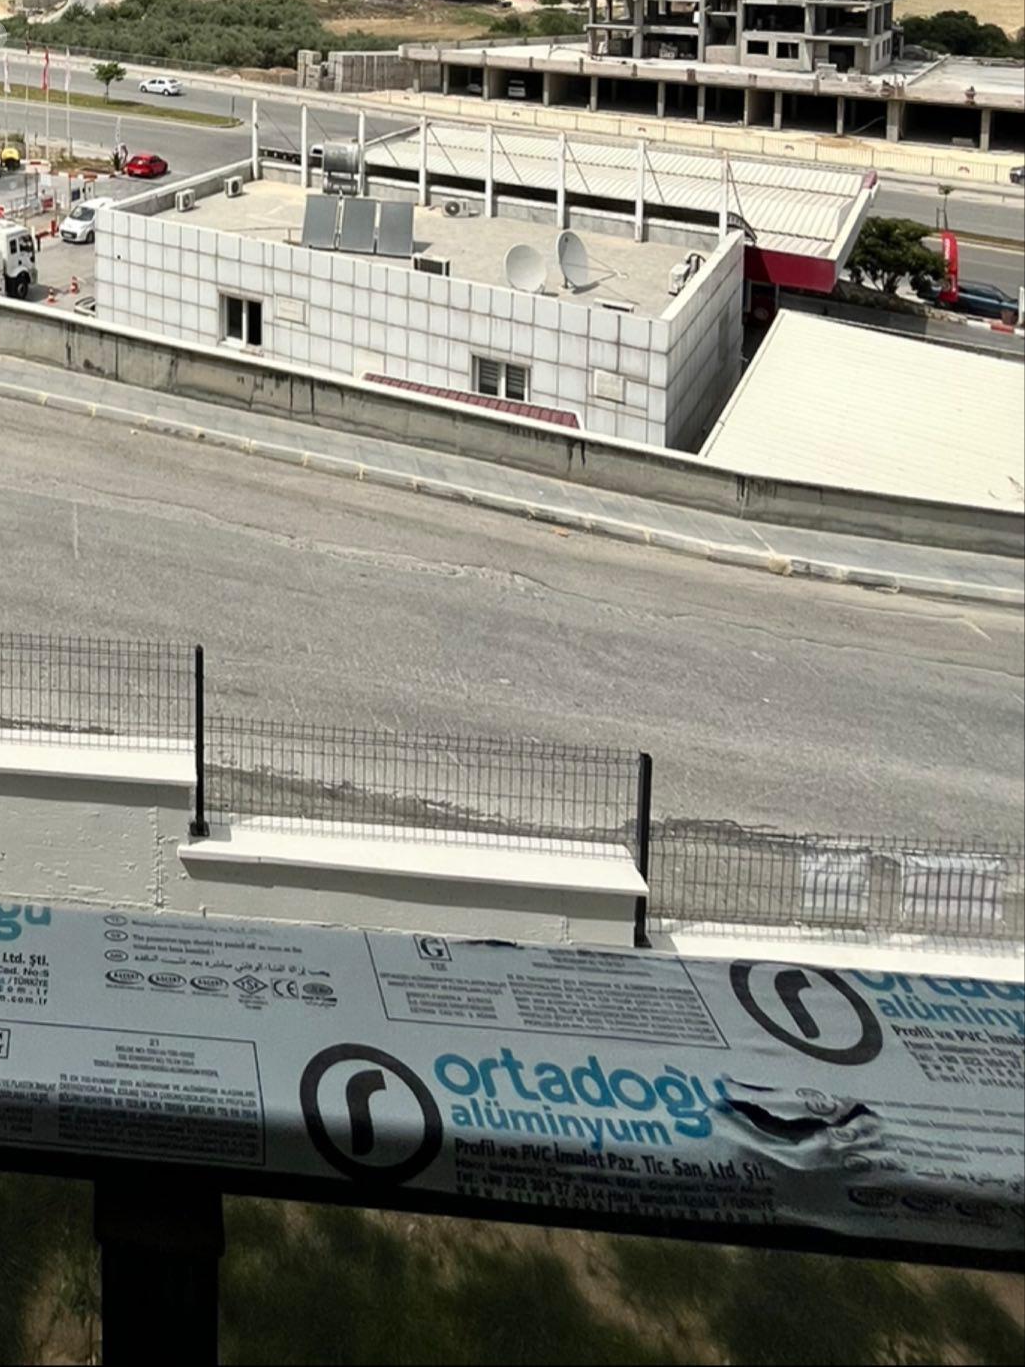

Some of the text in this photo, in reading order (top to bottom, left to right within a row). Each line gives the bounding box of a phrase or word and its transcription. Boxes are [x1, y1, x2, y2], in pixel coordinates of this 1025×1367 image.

[3, 952, 25, 965] Ltd.
[29, 954, 49, 967] Şti.
[420, 936, 445, 957] G
[434, 1047, 733, 1138] ortadoğu
[451, 1097, 672, 1150] alüminyum
[455, 1137, 495, 1157] Profil
[500, 1146, 518, 1160] ve
[522, 1144, 552, 1163] PVC
[553, 1141, 604, 1169] İmalat
[606, 1152, 640, 1173] Paz.
[640, 1154, 669, 1175] Tic.
[672, 1158, 707, 1177] San.
[708, 1159, 741, 1180] Ltd.
